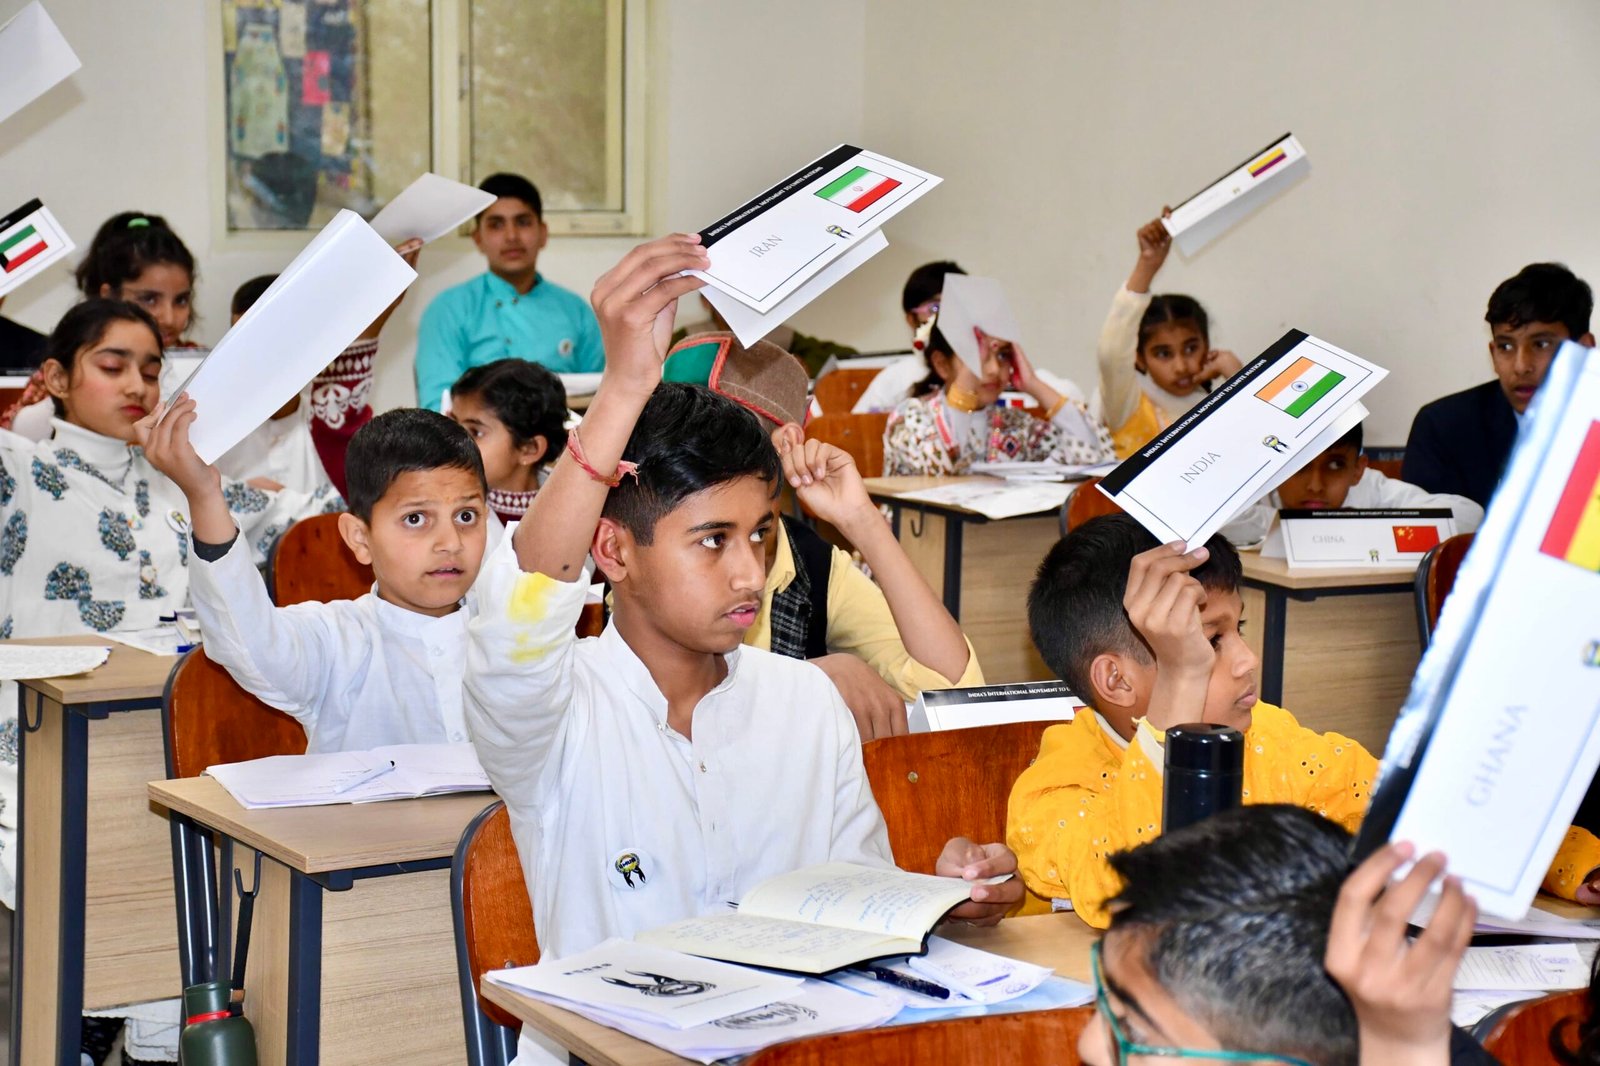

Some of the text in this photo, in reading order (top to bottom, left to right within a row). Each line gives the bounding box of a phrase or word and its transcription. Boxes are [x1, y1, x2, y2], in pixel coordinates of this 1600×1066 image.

[749, 234, 783, 258] IRAN
[1180, 452, 1221, 484] INDIA
[1312, 535, 1345, 544] CHINA
[1466, 704, 1529, 807] GHANA
